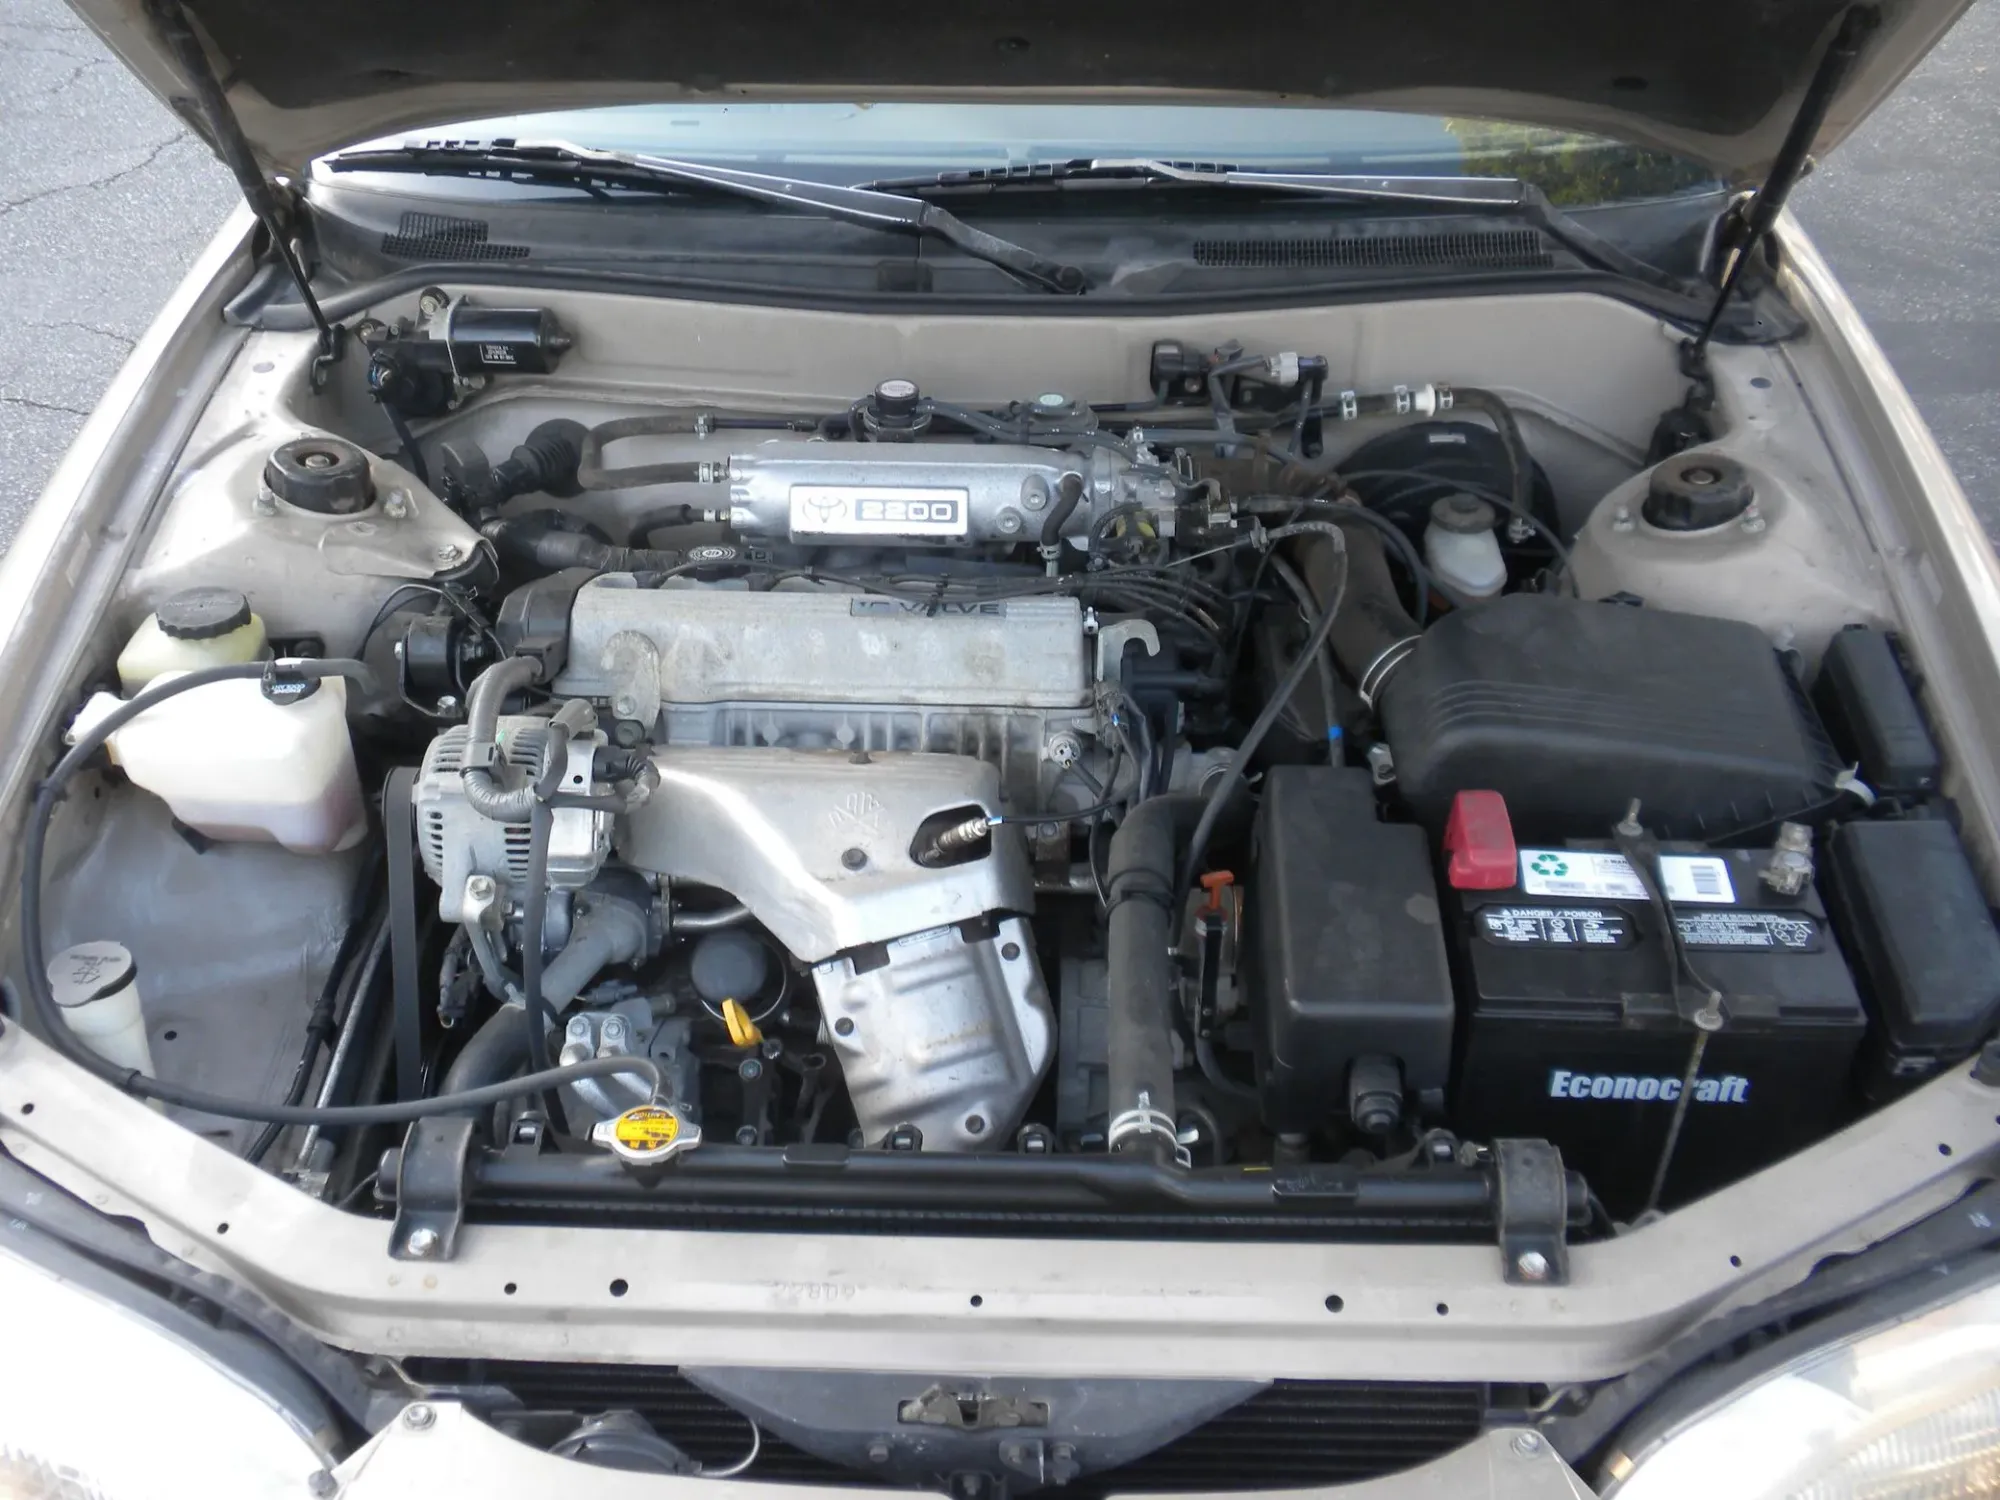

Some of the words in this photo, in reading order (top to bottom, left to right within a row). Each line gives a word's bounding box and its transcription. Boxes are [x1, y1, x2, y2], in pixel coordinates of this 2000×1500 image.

[861, 500, 952, 521] 2200
[1512, 909, 1554, 917] DANGER
[1550, 1071, 1748, 1102] Econocaft
